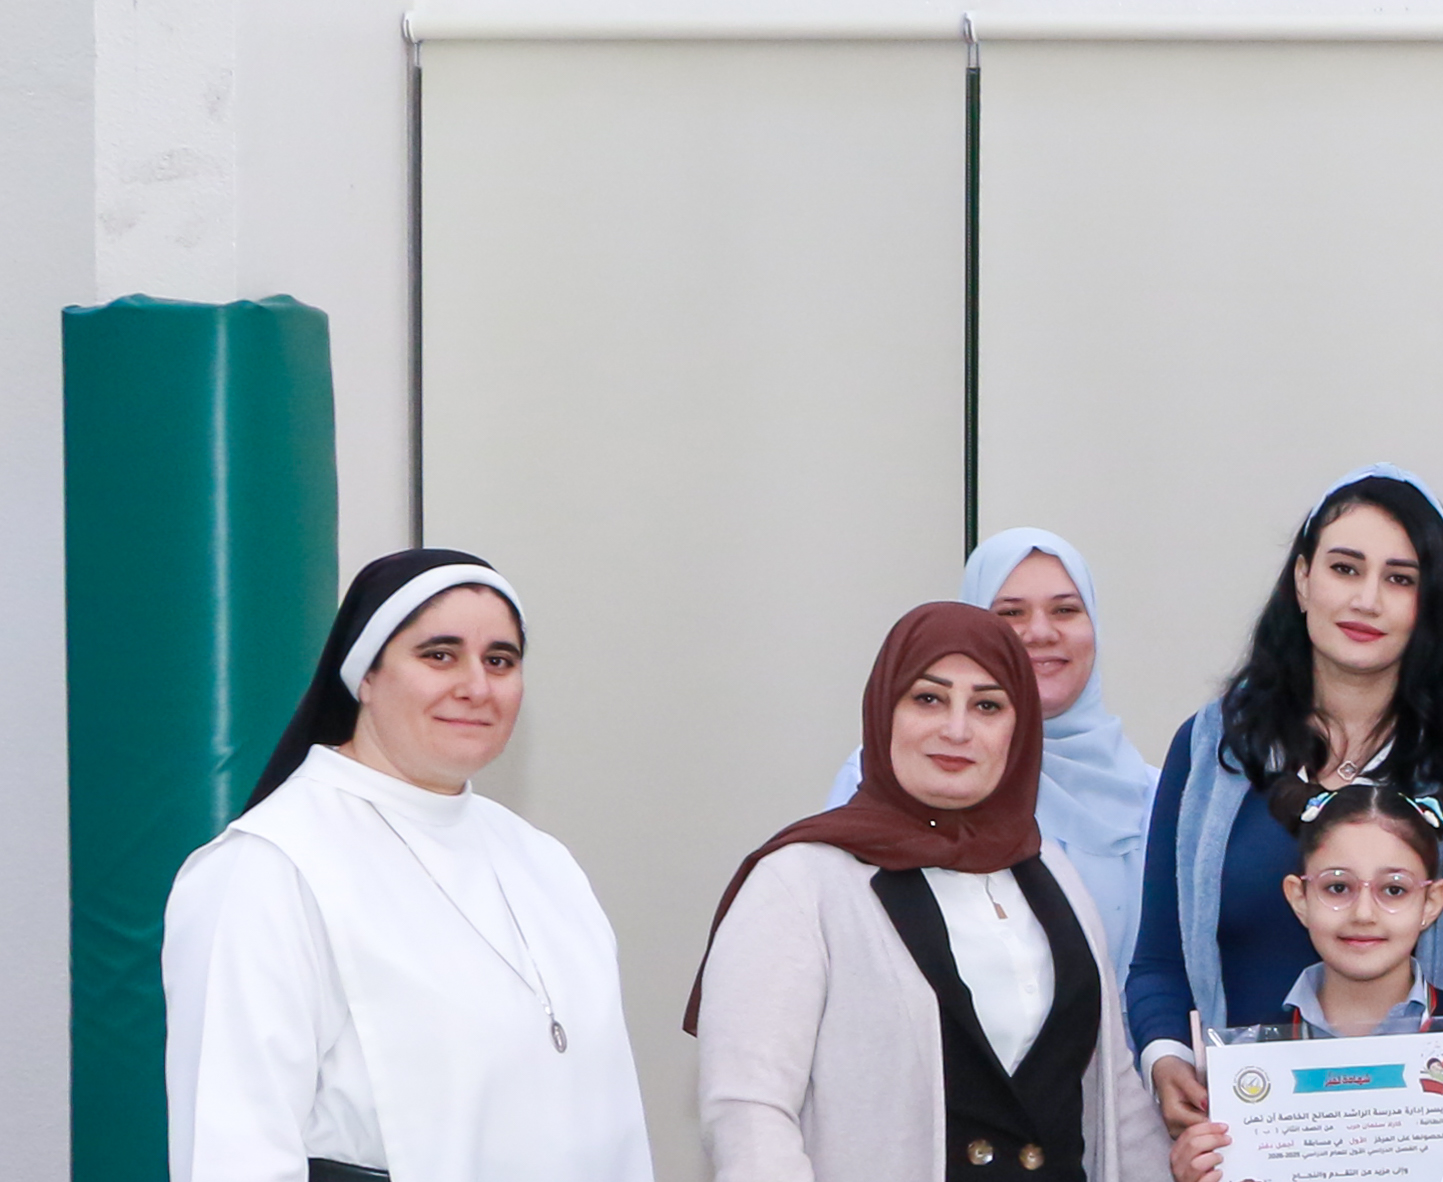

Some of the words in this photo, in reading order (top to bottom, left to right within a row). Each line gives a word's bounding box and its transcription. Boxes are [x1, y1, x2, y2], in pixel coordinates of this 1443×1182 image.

[1342, 1108, 1371, 1118] الراشد
[1372, 1107, 1402, 1117] مدرسة
[1404, 1105, 1424, 1116] إدارة
[1424, 1106, 1443, 1115] يسر
[1265, 1112, 1276, 1123] أن
[1277, 1112, 1309, 1121] الخاصة
[1311, 1110, 1341, 1122] الصالح
[1323, 1124, 1334, 1132] من
[1303, 1138, 1331, 1148] مسابقة
[1332, 1138, 1343, 1148] في
[1396, 1134, 1410, 1142] على
[1418, 1144, 1428, 1153] في
